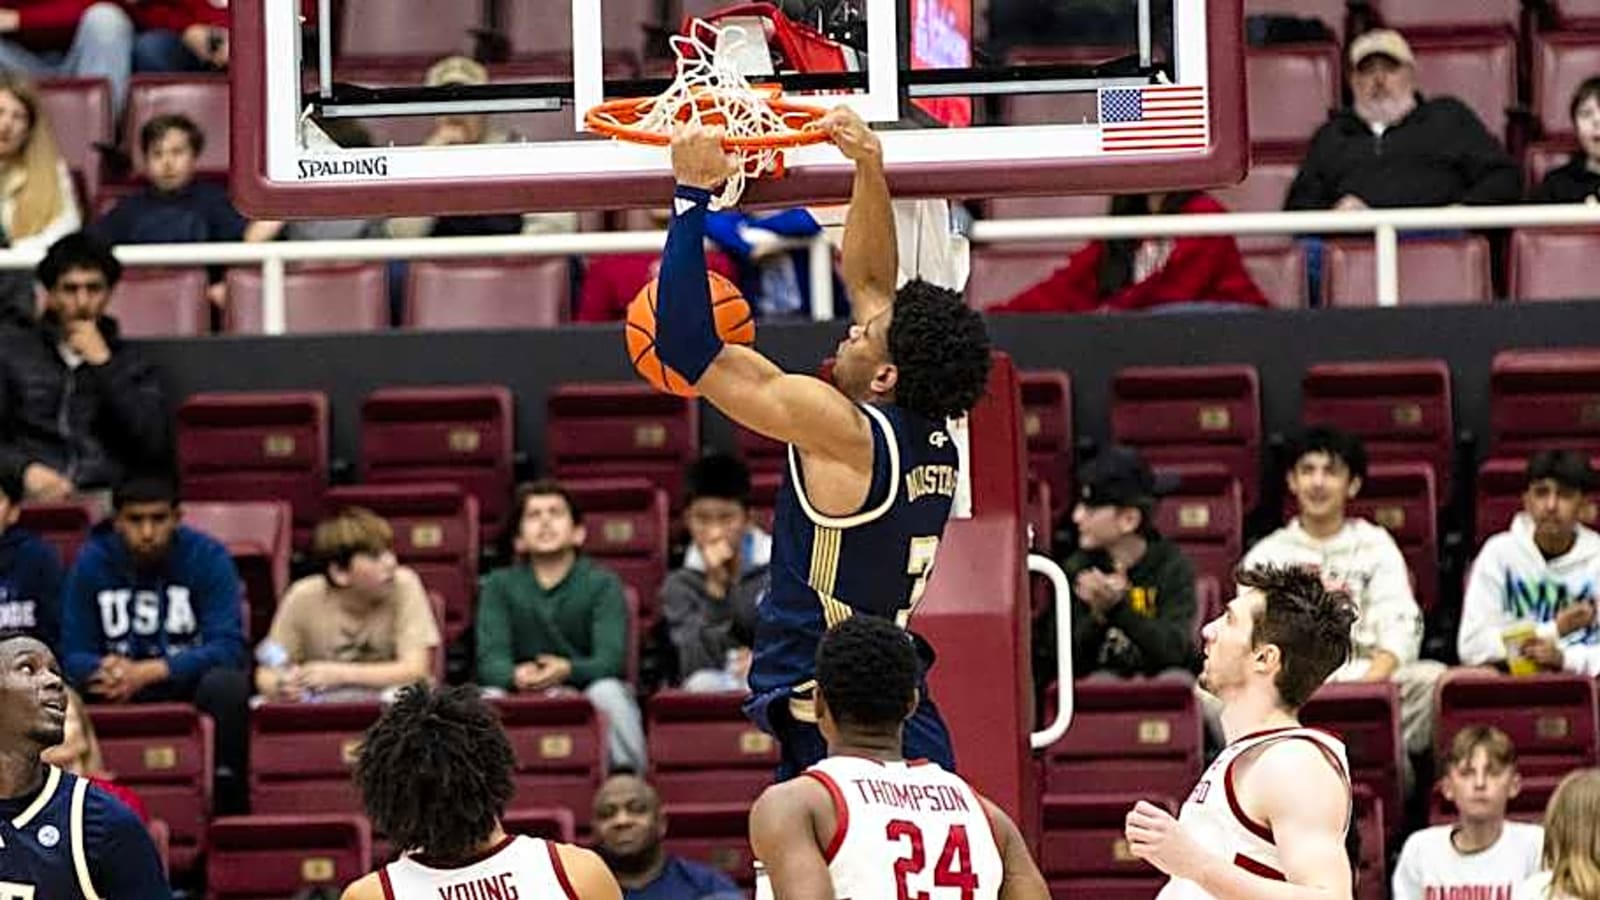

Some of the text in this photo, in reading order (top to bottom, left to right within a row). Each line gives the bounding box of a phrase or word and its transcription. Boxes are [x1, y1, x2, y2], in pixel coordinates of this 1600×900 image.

[297, 155, 388, 180] SPALDING
[97, 584, 197, 639] USA
[850, 778, 970, 813] THOMPSON
[885, 818, 980, 900] 24
[437, 871, 519, 900] YOUNG
